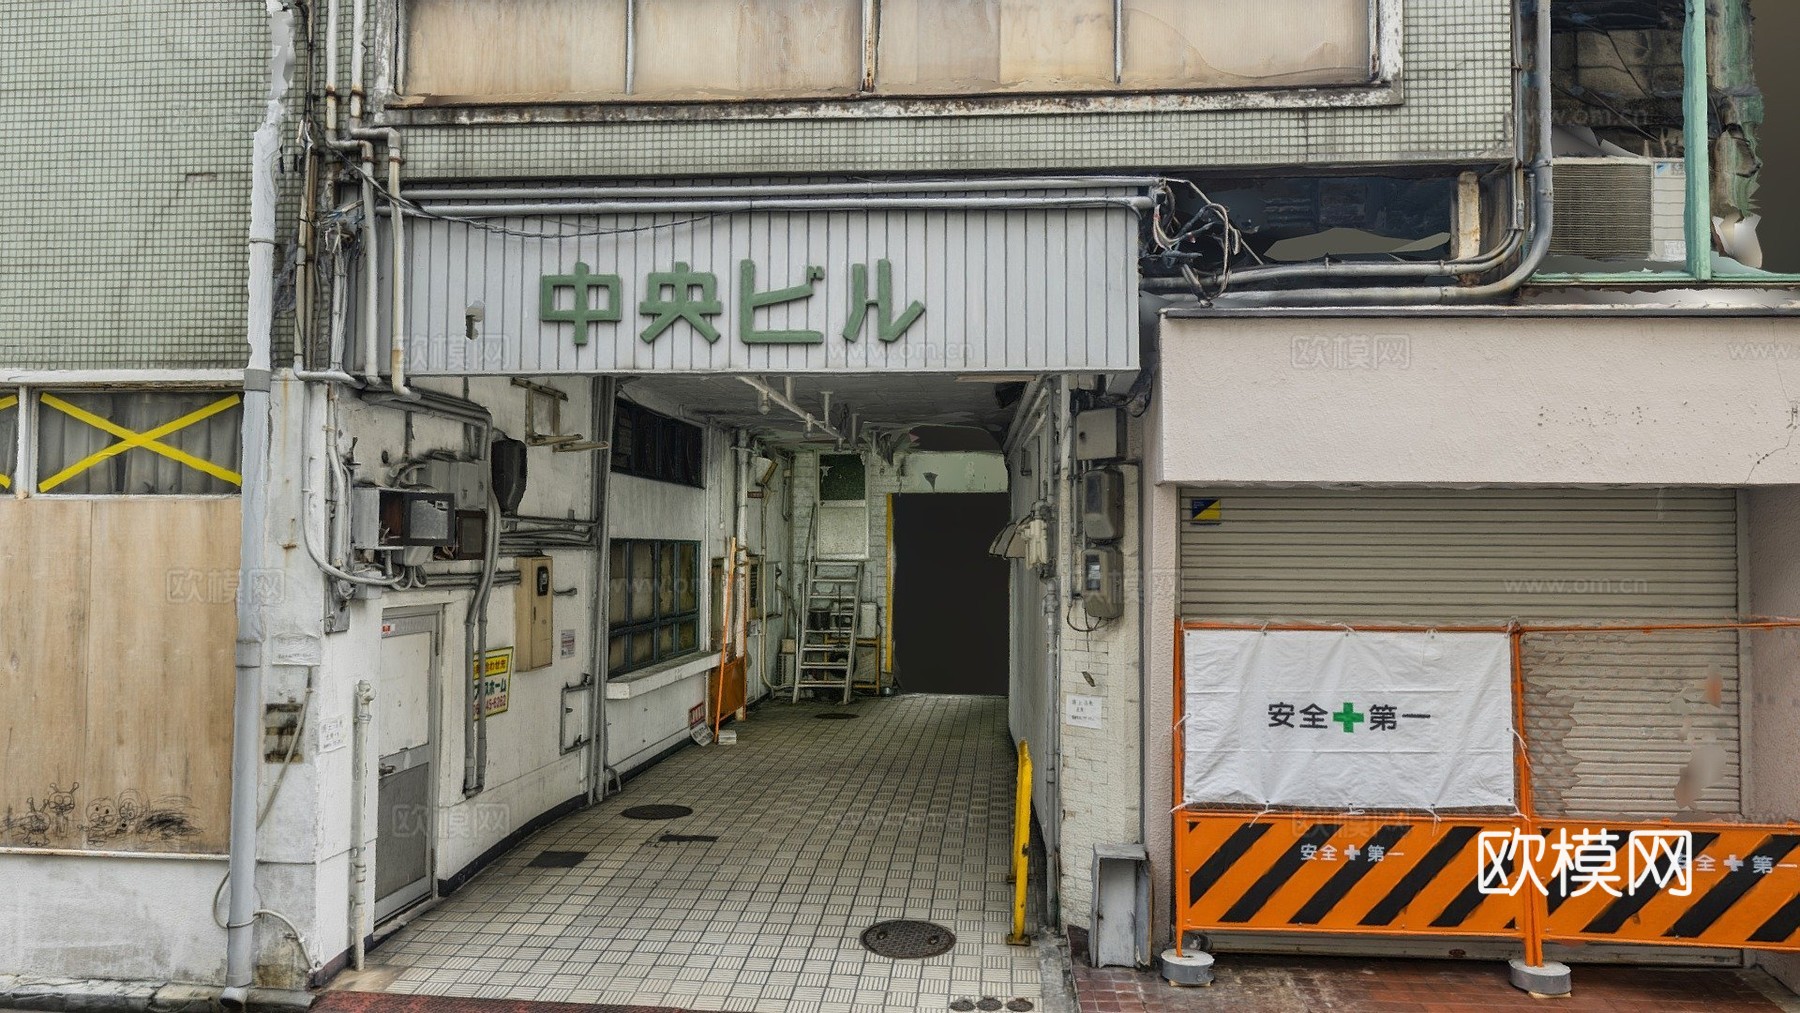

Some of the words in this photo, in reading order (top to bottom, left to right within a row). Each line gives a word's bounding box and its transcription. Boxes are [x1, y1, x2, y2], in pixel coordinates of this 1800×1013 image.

[541, 259, 925, 346] 中央ビル
[1267, 702, 1329, 729] 安全
[1368, 703, 1432, 732] 第一
[1300, 843, 1338, 861] 安全
[1367, 844, 1405, 862] 第一
[1752, 855, 1798, 874] 第一
